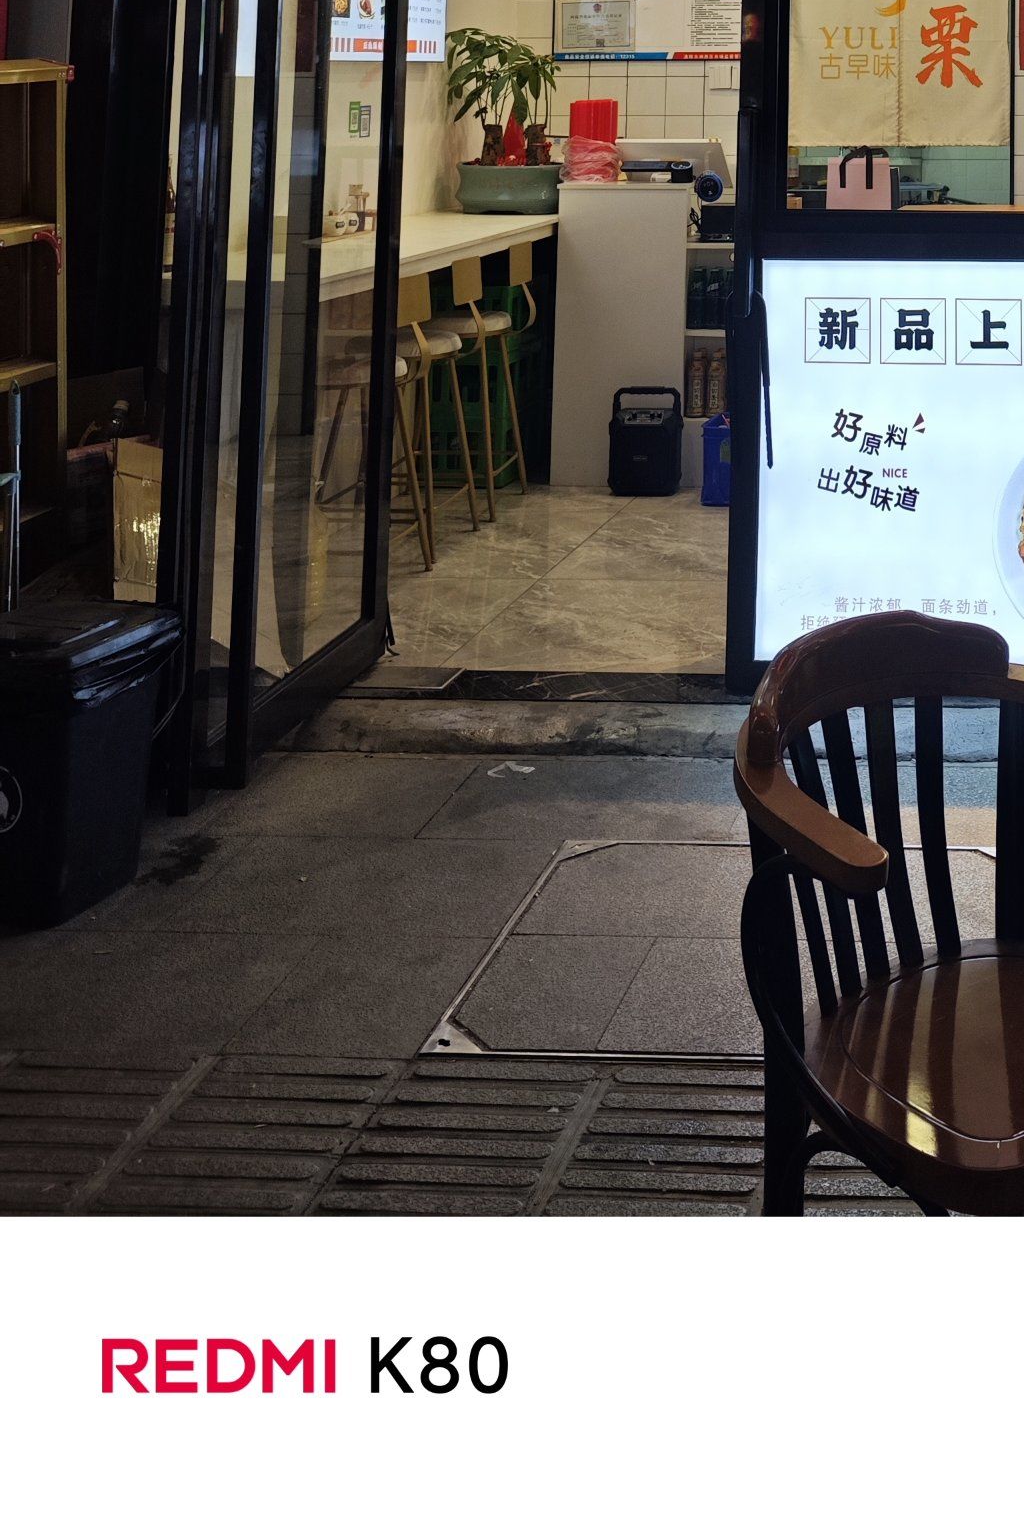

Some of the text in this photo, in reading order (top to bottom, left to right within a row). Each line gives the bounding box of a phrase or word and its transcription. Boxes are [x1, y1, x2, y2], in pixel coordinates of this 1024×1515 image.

[819, 26, 898, 50] YULI
[916, 5, 983, 88] 栗
[819, 53, 898, 80] 古早味
[831, 408, 908, 456] 好原料
[818, 465, 920, 513] 出好味道
[882, 468, 908, 478] NICE
